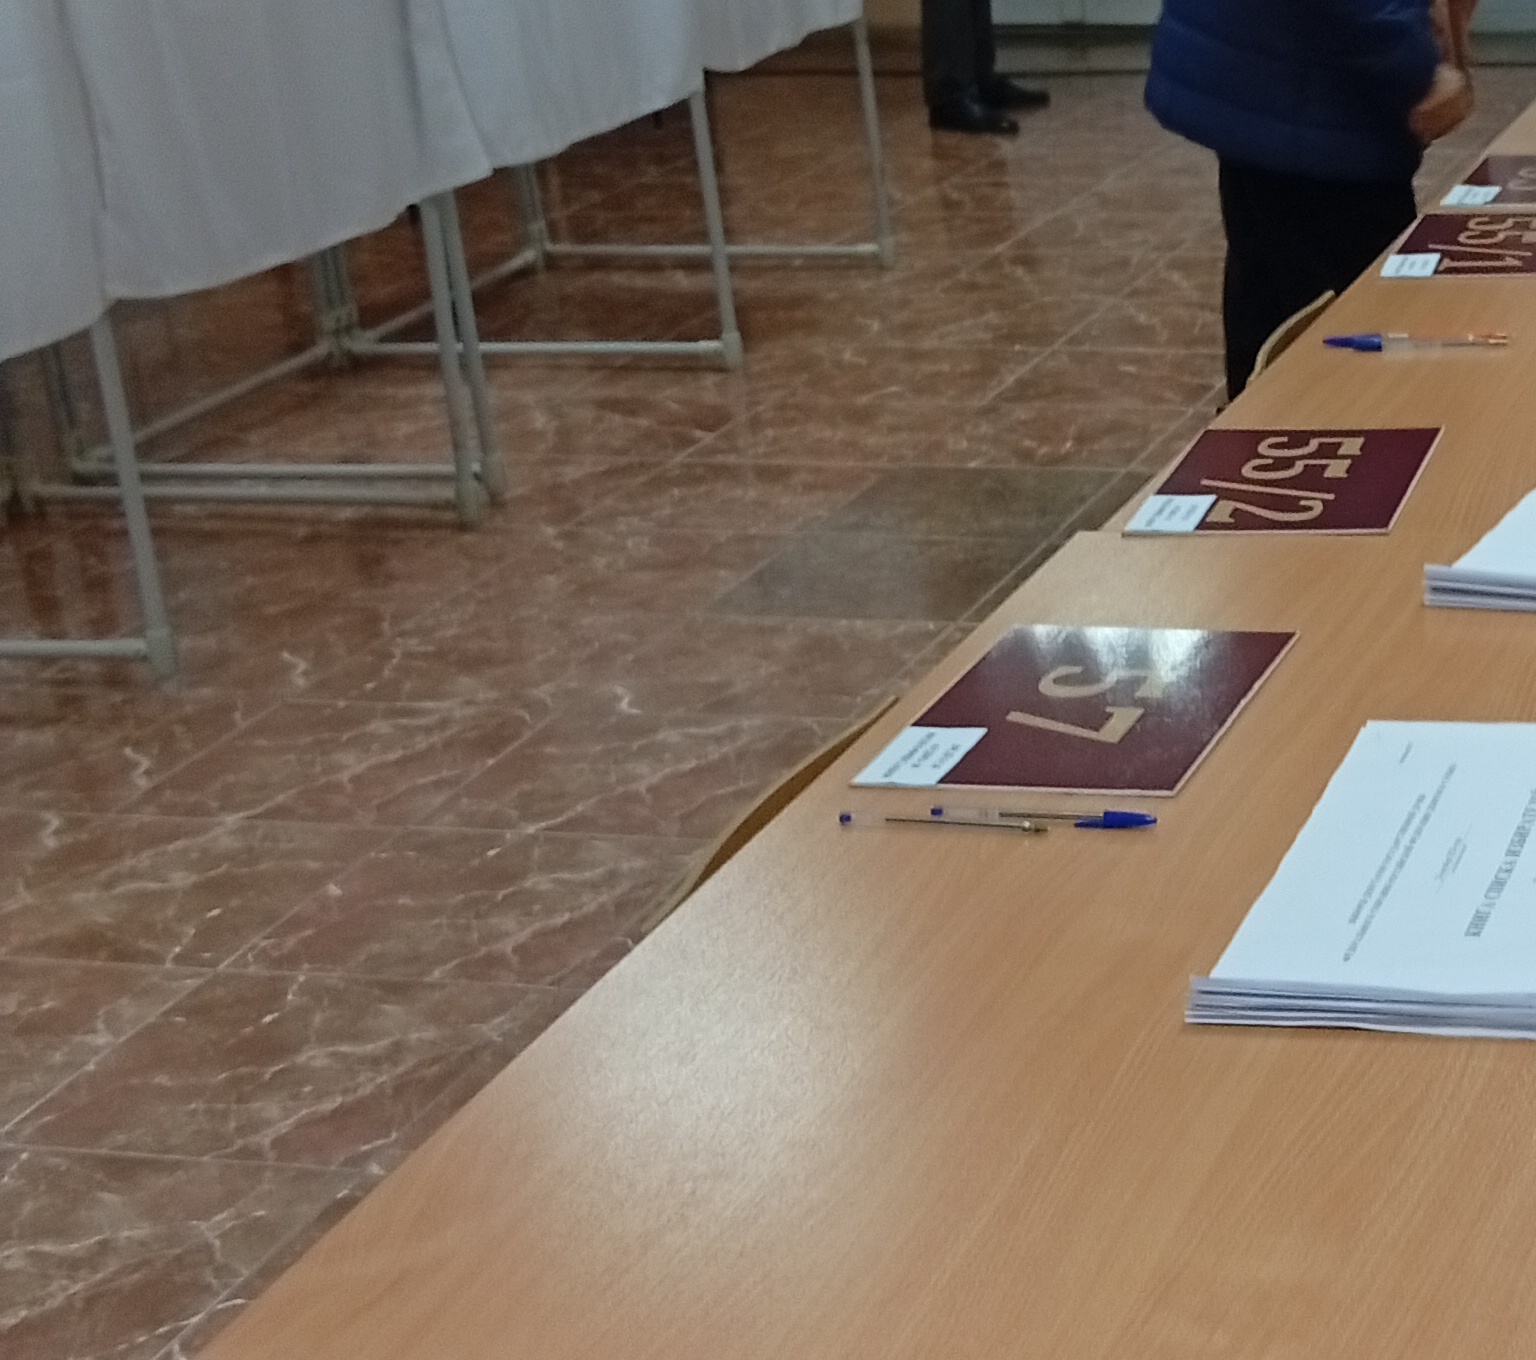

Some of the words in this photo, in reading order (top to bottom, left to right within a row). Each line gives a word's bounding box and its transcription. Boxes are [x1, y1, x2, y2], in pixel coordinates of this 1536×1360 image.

[1200, 436, 1365, 523] 55/2
[1006, 665, 1167, 744] 57
[1465, 901, 1496, 937] КНИГА
[1484, 860, 1517, 900] СПИСКА
